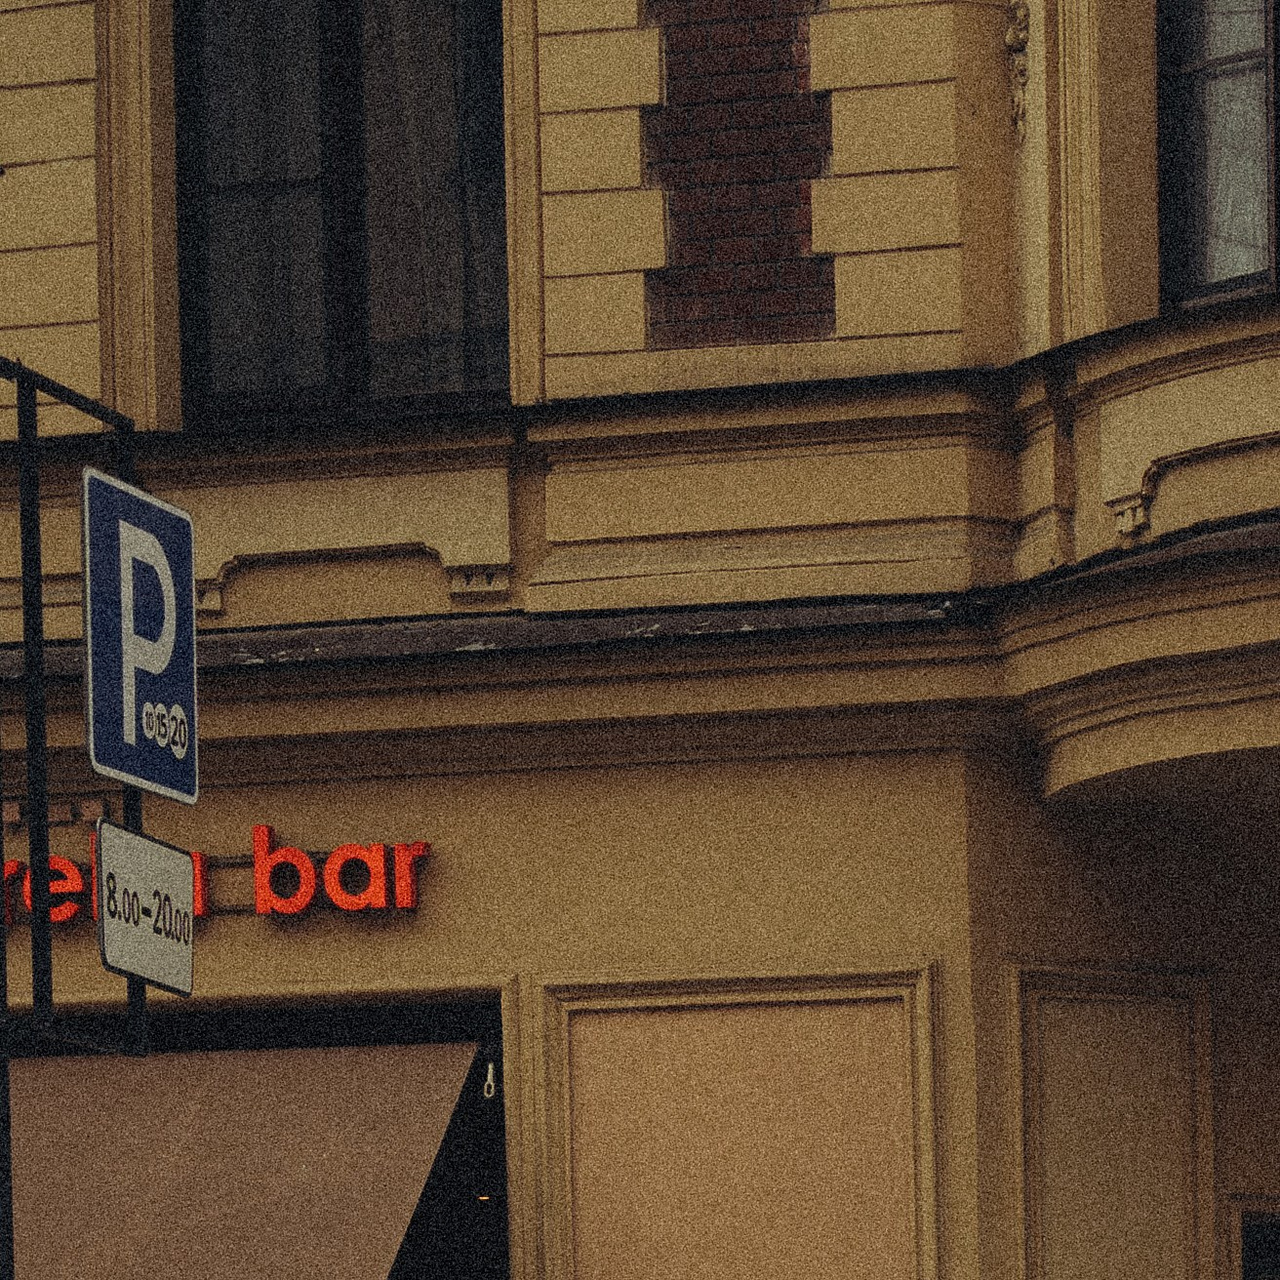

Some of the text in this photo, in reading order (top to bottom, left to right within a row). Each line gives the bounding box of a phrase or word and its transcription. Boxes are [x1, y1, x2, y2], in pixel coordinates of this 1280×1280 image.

[119, 519, 177, 745] P
[156, 712, 168, 739] 15
[170, 714, 187, 749] 20
[253, 824, 431, 915] bar
